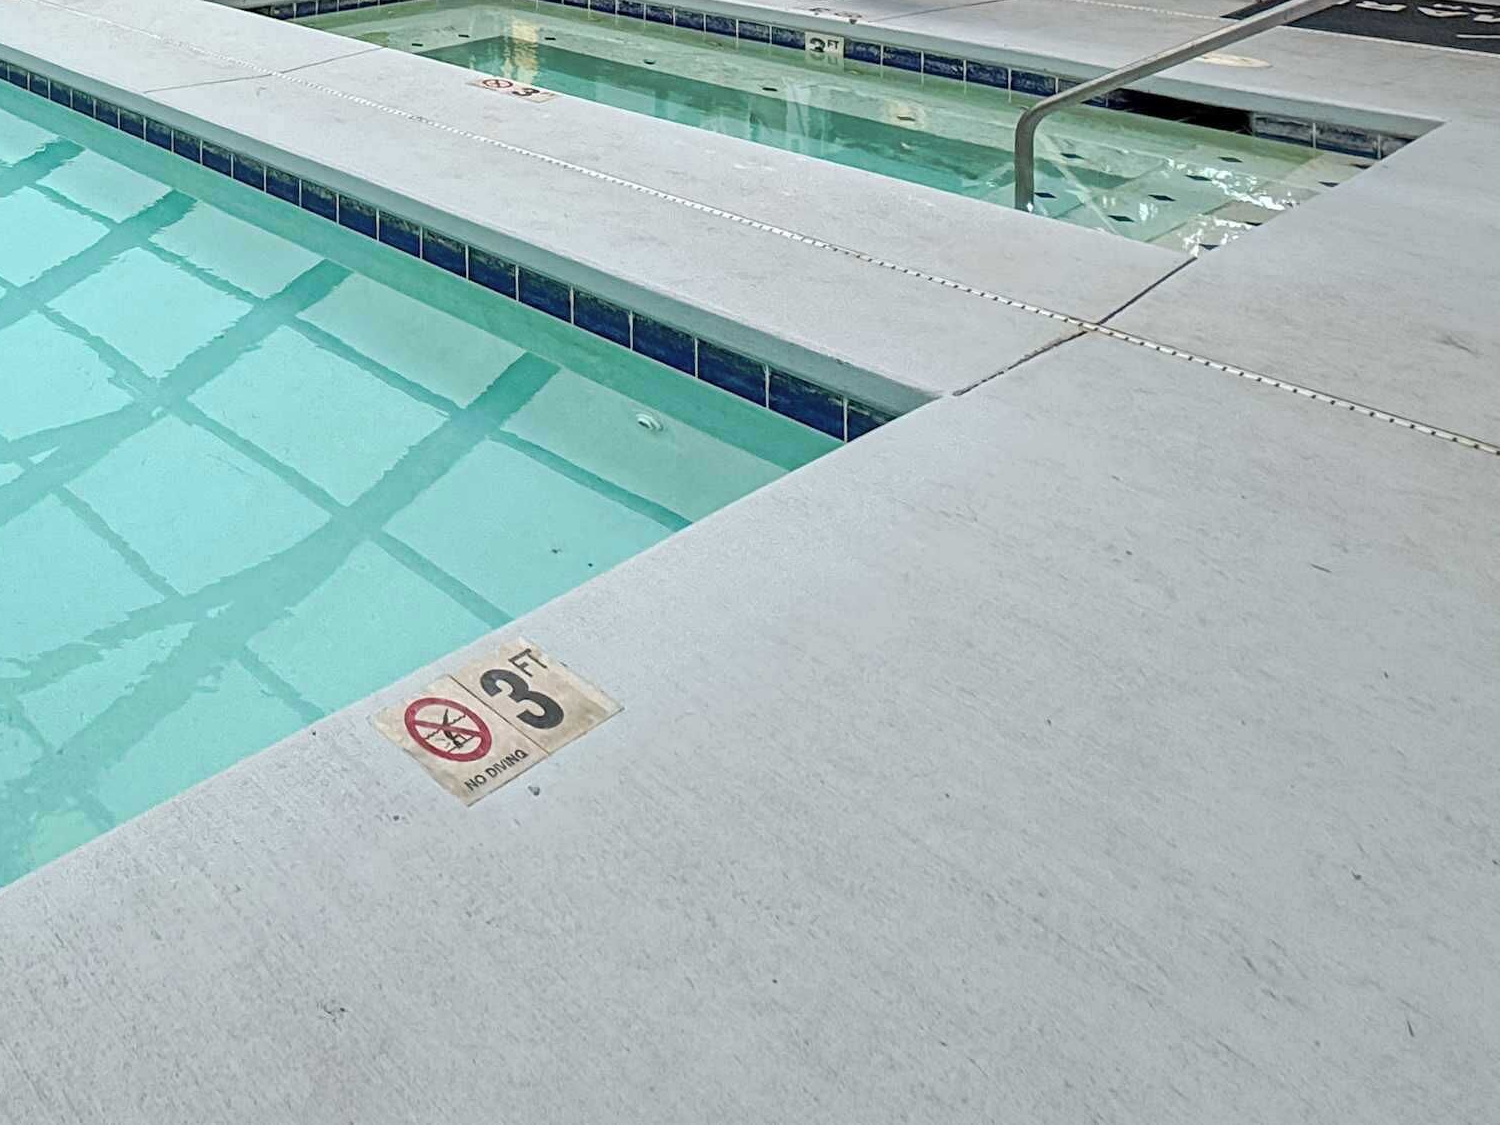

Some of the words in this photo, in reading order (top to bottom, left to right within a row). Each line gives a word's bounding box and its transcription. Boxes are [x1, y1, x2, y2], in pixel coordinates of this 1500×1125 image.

[508, 648, 548, 678] FT
[479, 668, 565, 730] 3
[464, 774, 487, 792] NO
[485, 748, 529, 778] DIVING
